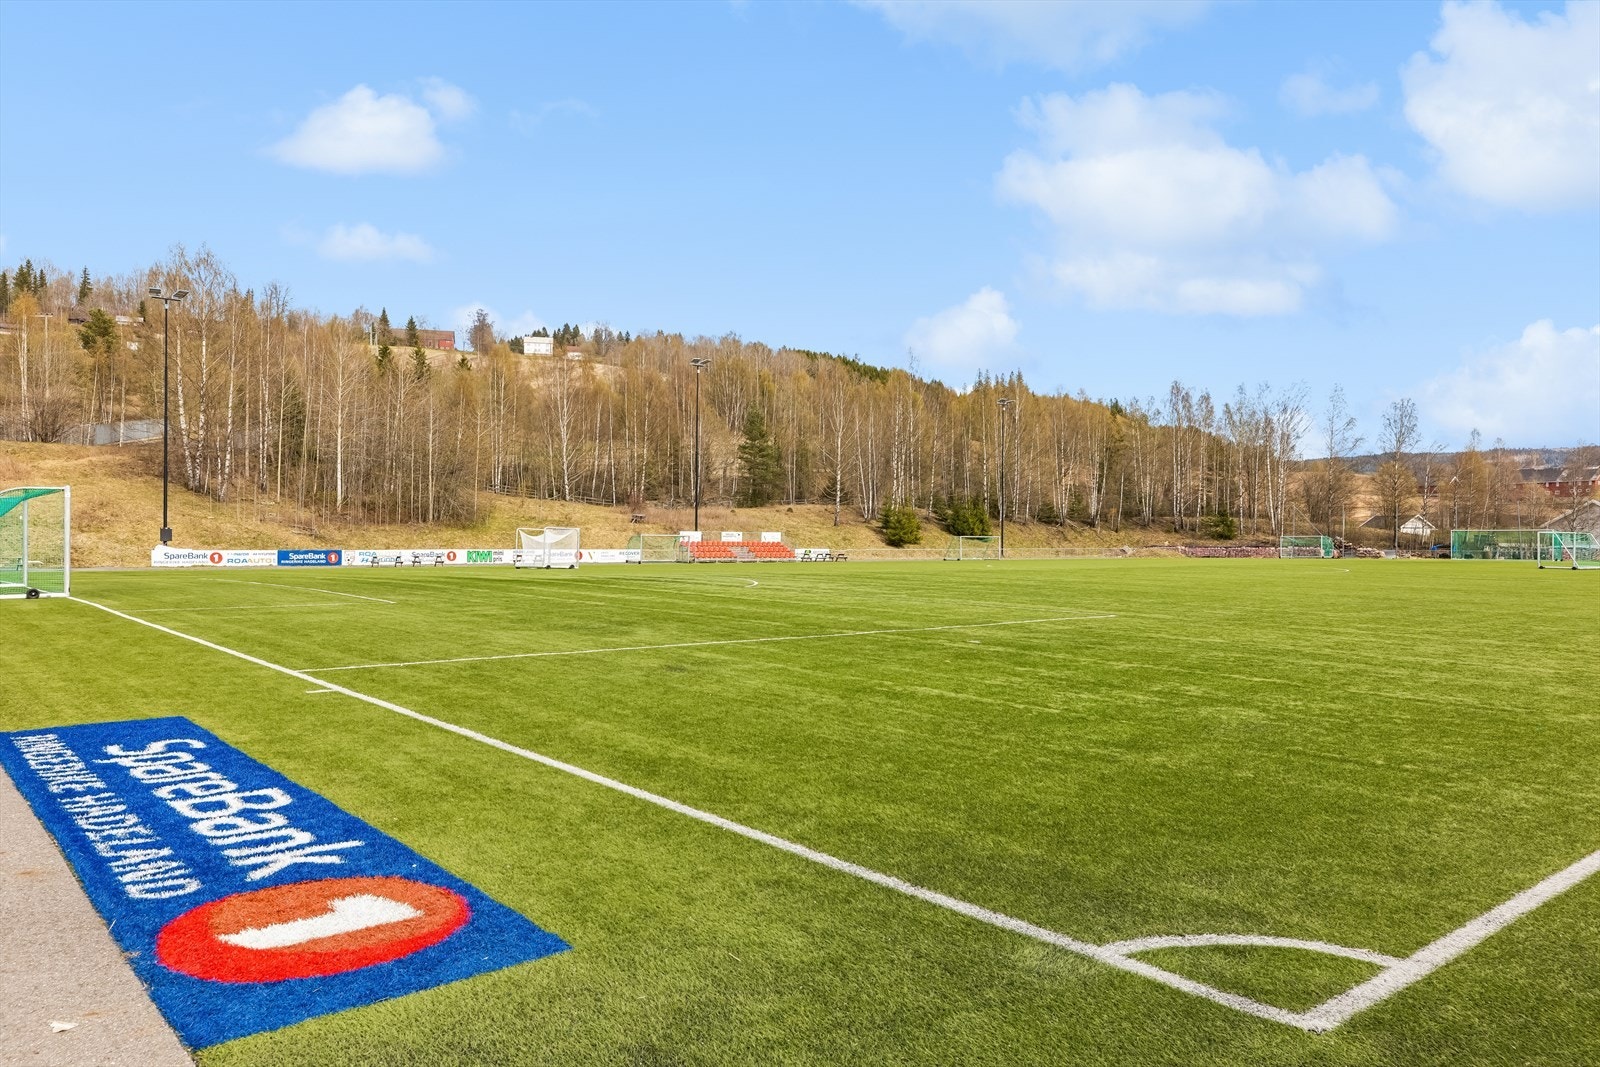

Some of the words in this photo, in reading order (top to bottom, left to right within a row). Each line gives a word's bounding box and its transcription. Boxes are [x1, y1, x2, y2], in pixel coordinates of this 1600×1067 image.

[467, 551, 492, 562] KIWI
[57, 792, 204, 899] HADELAND
[92, 739, 363, 881] SpareBank
[213, 894, 424, 949] 1
